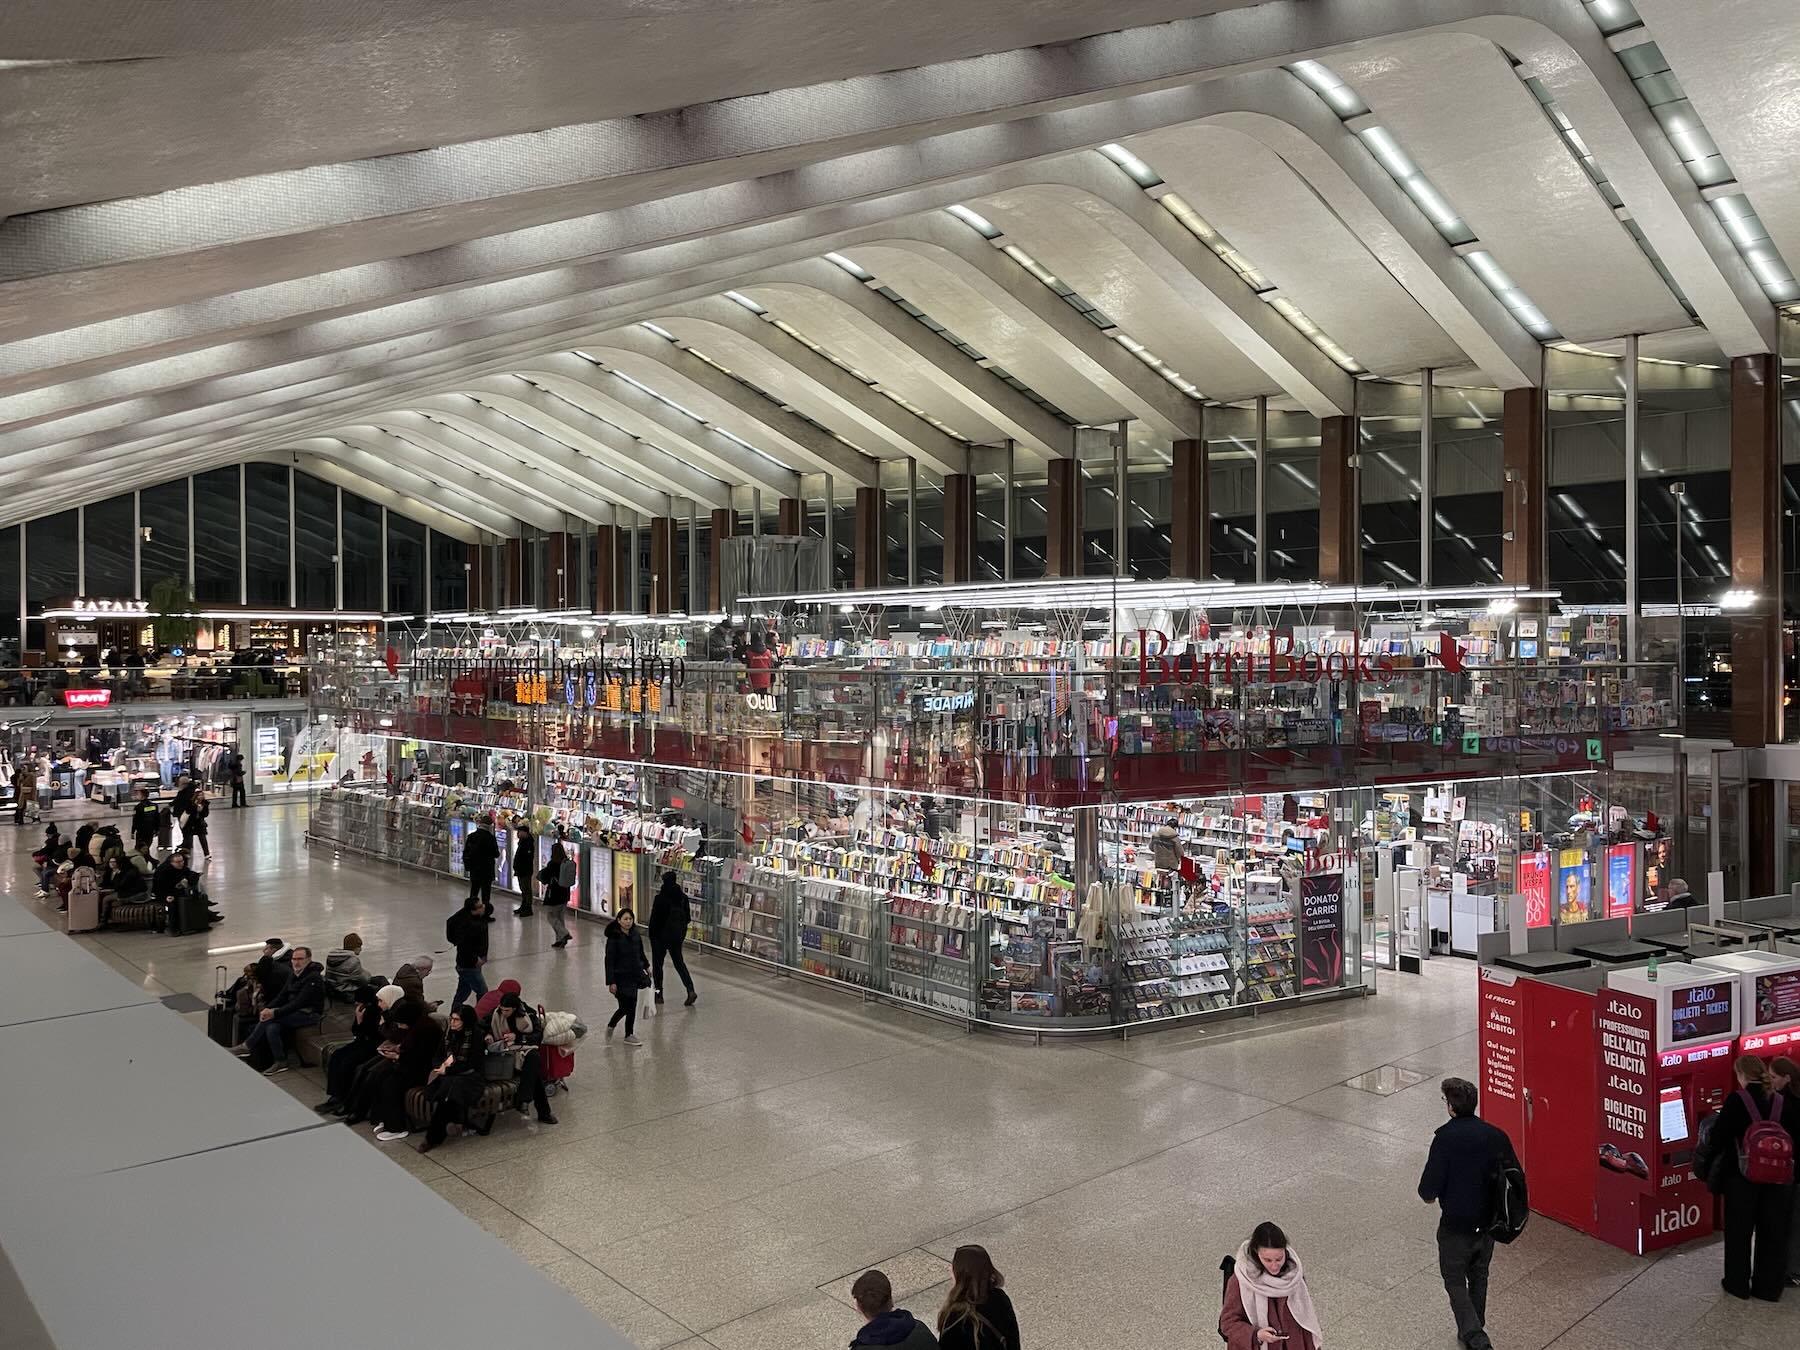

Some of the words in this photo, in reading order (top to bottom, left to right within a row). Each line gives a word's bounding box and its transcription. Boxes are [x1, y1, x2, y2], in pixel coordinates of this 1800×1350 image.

[73, 601, 149, 612] EATALY
[1136, 629, 1256, 686] Borri
[1266, 629, 1394, 684] Books
[1304, 893, 1339, 906] DONATO
[1306, 904, 1338, 917] CARRISI
[1493, 995, 1516, 1006] FRECCE
[1490, 1012, 1511, 1024] PARTI
[1672, 1005, 1701, 1021] BIGLIETTI
[1705, 1000, 1729, 1016] TICKETS
[1602, 1019, 1650, 1041] PROFESSIONISTI
[1486, 1040, 1499, 1050] Qui
[1499, 1044, 1516, 1055] trovi
[1602, 1031, 1647, 1058] DELL'ALTA
[1496, 1052, 1510, 1062] tuoi
[1603, 1049, 1647, 1076] VELOCITÀ
[1603, 1097, 1647, 1124] BIGLIETTI
[1606, 1114, 1644, 1140] TICKETS
